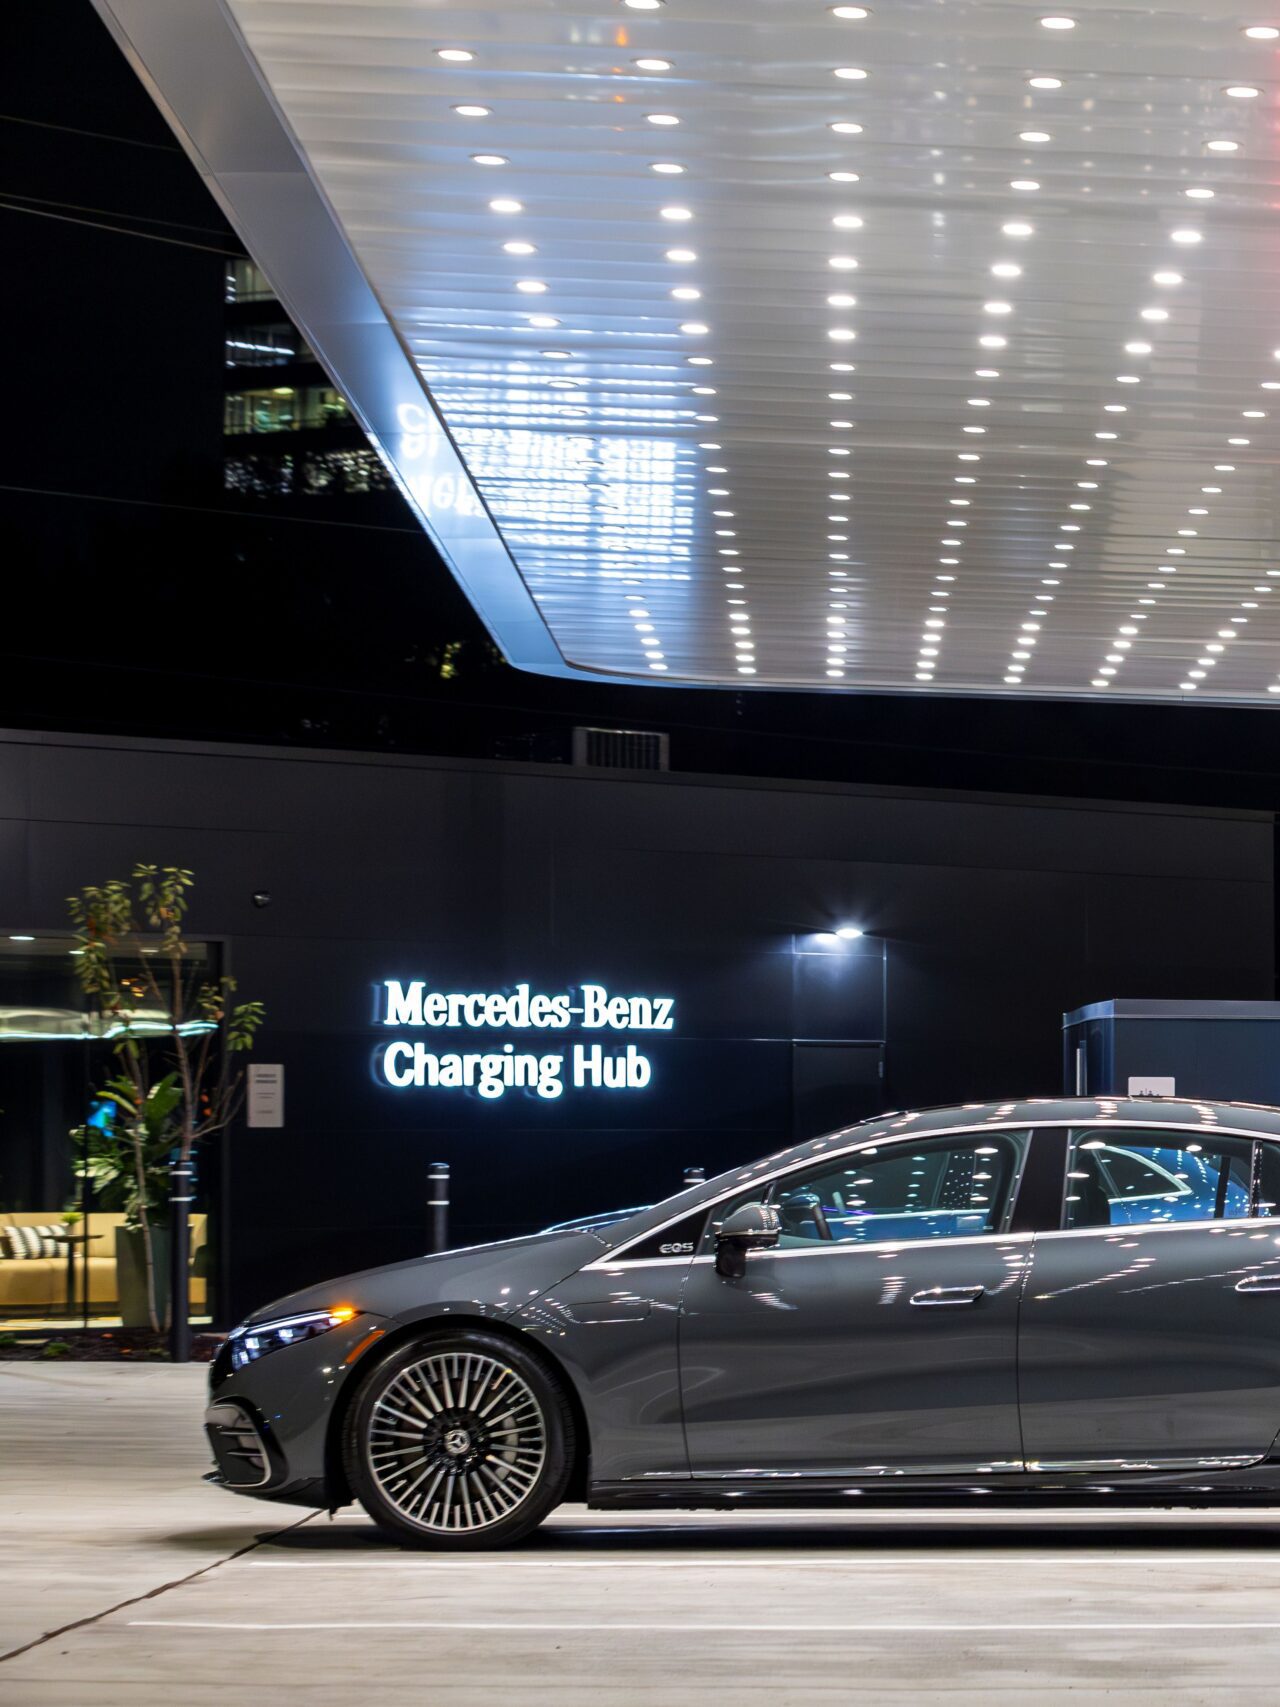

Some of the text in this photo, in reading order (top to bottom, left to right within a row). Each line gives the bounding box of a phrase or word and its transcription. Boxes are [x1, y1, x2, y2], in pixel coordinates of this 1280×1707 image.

[383, 980, 675, 1030] Mercedes-Benz
[383, 1041, 653, 1099] Charging Hub
[659, 1242, 694, 1254] EQS
